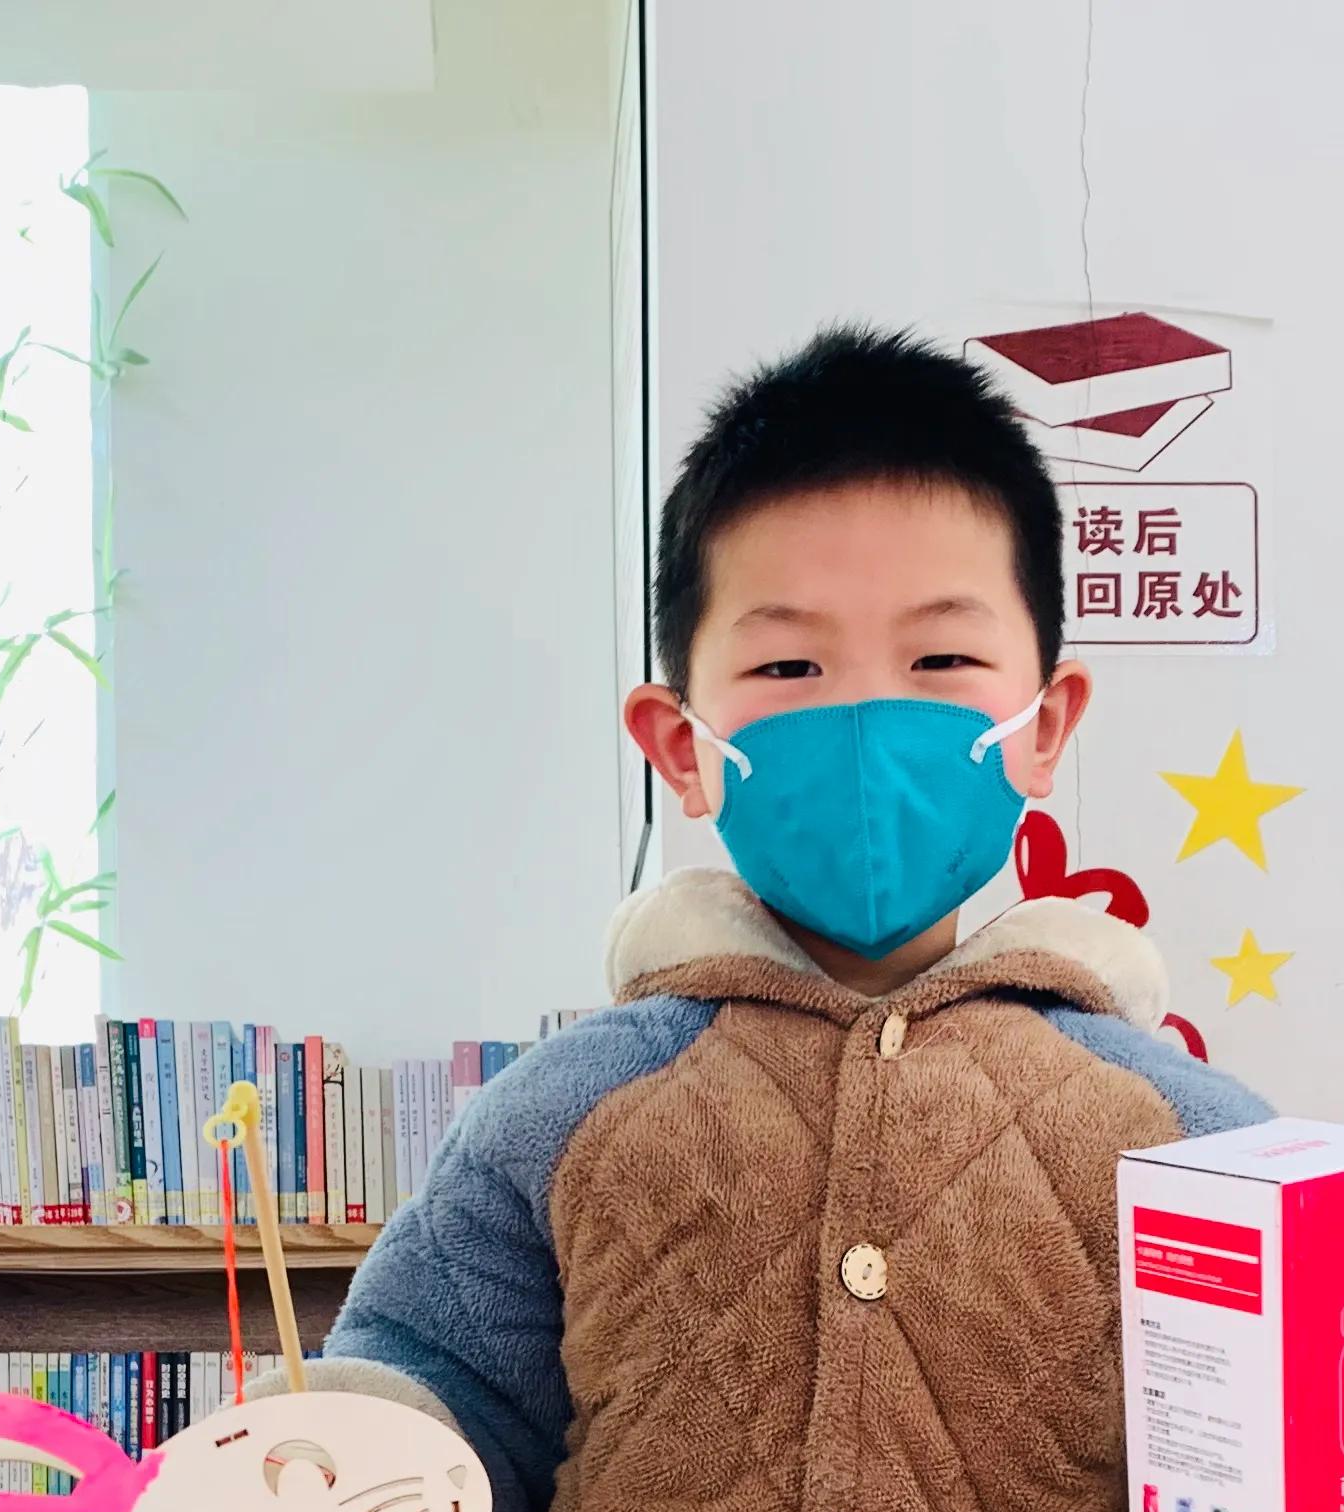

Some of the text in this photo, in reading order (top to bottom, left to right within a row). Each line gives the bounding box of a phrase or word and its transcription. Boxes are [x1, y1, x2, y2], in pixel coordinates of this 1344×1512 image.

[1072, 505, 1182, 556] 读后
[1076, 570, 1243, 620] 回原处
